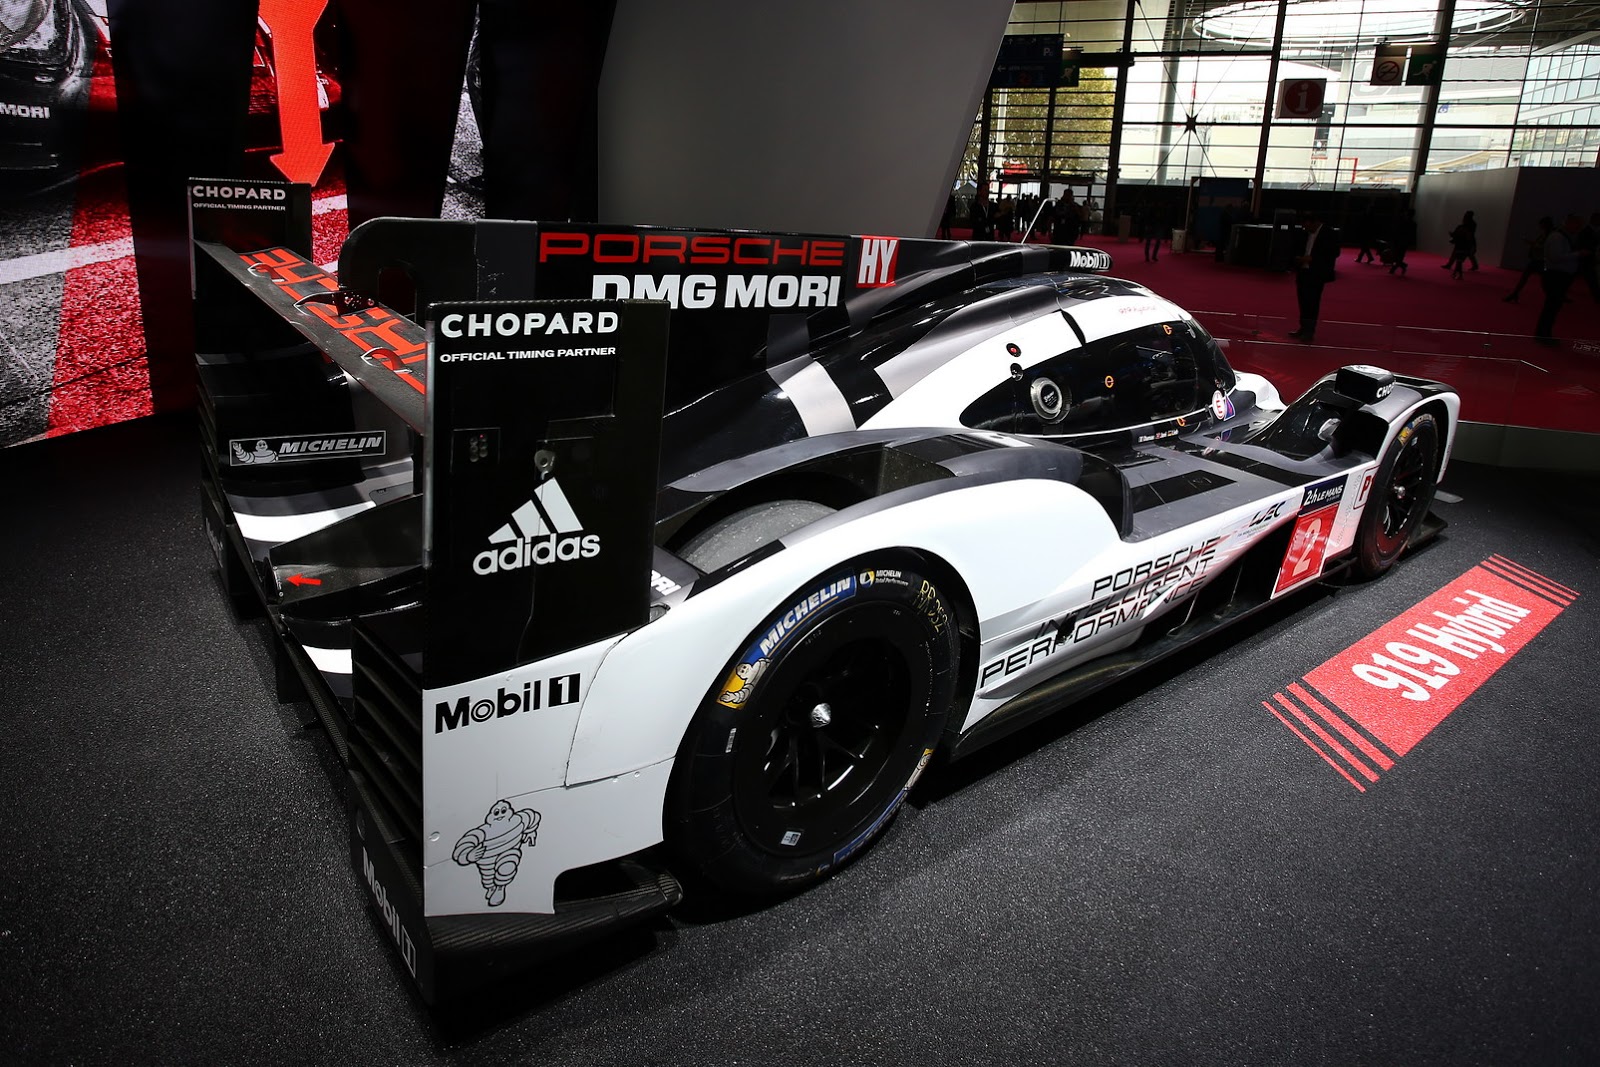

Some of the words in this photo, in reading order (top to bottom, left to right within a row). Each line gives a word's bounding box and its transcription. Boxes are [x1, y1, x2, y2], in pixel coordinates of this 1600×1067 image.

[0, 102, 51, 119] MORI
[193, 185, 286, 200] CHOPARD
[539, 232, 845, 266] PORSCHE
[858, 238, 898, 284] HY
[1070, 251, 1099, 268] Mobil
[592, 274, 716, 309] DMG
[724, 274, 841, 309] MORI
[440, 312, 618, 338] CHOPARD
[440, 351, 506, 363] OFFICIAL
[507, 349, 555, 360] TIMING
[556, 347, 616, 358] PARTNER
[279, 436, 382, 454] MICHELIN
[1325, 484, 1344, 498] MANS
[1249, 501, 1286, 528] WEC
[473, 531, 601, 576] adidas
[1292, 518, 1321, 576] 2
[876, 569, 901, 579] MICHELIN
[1091, 536, 1221, 600] PORSCHE
[759, 577, 852, 657] MICHELIN
[1405, 589, 1532, 660] Hybrid
[1352, 641, 1461, 701] 919
[435, 681, 542, 734] Mobil
[362, 846, 400, 946] Mobil
